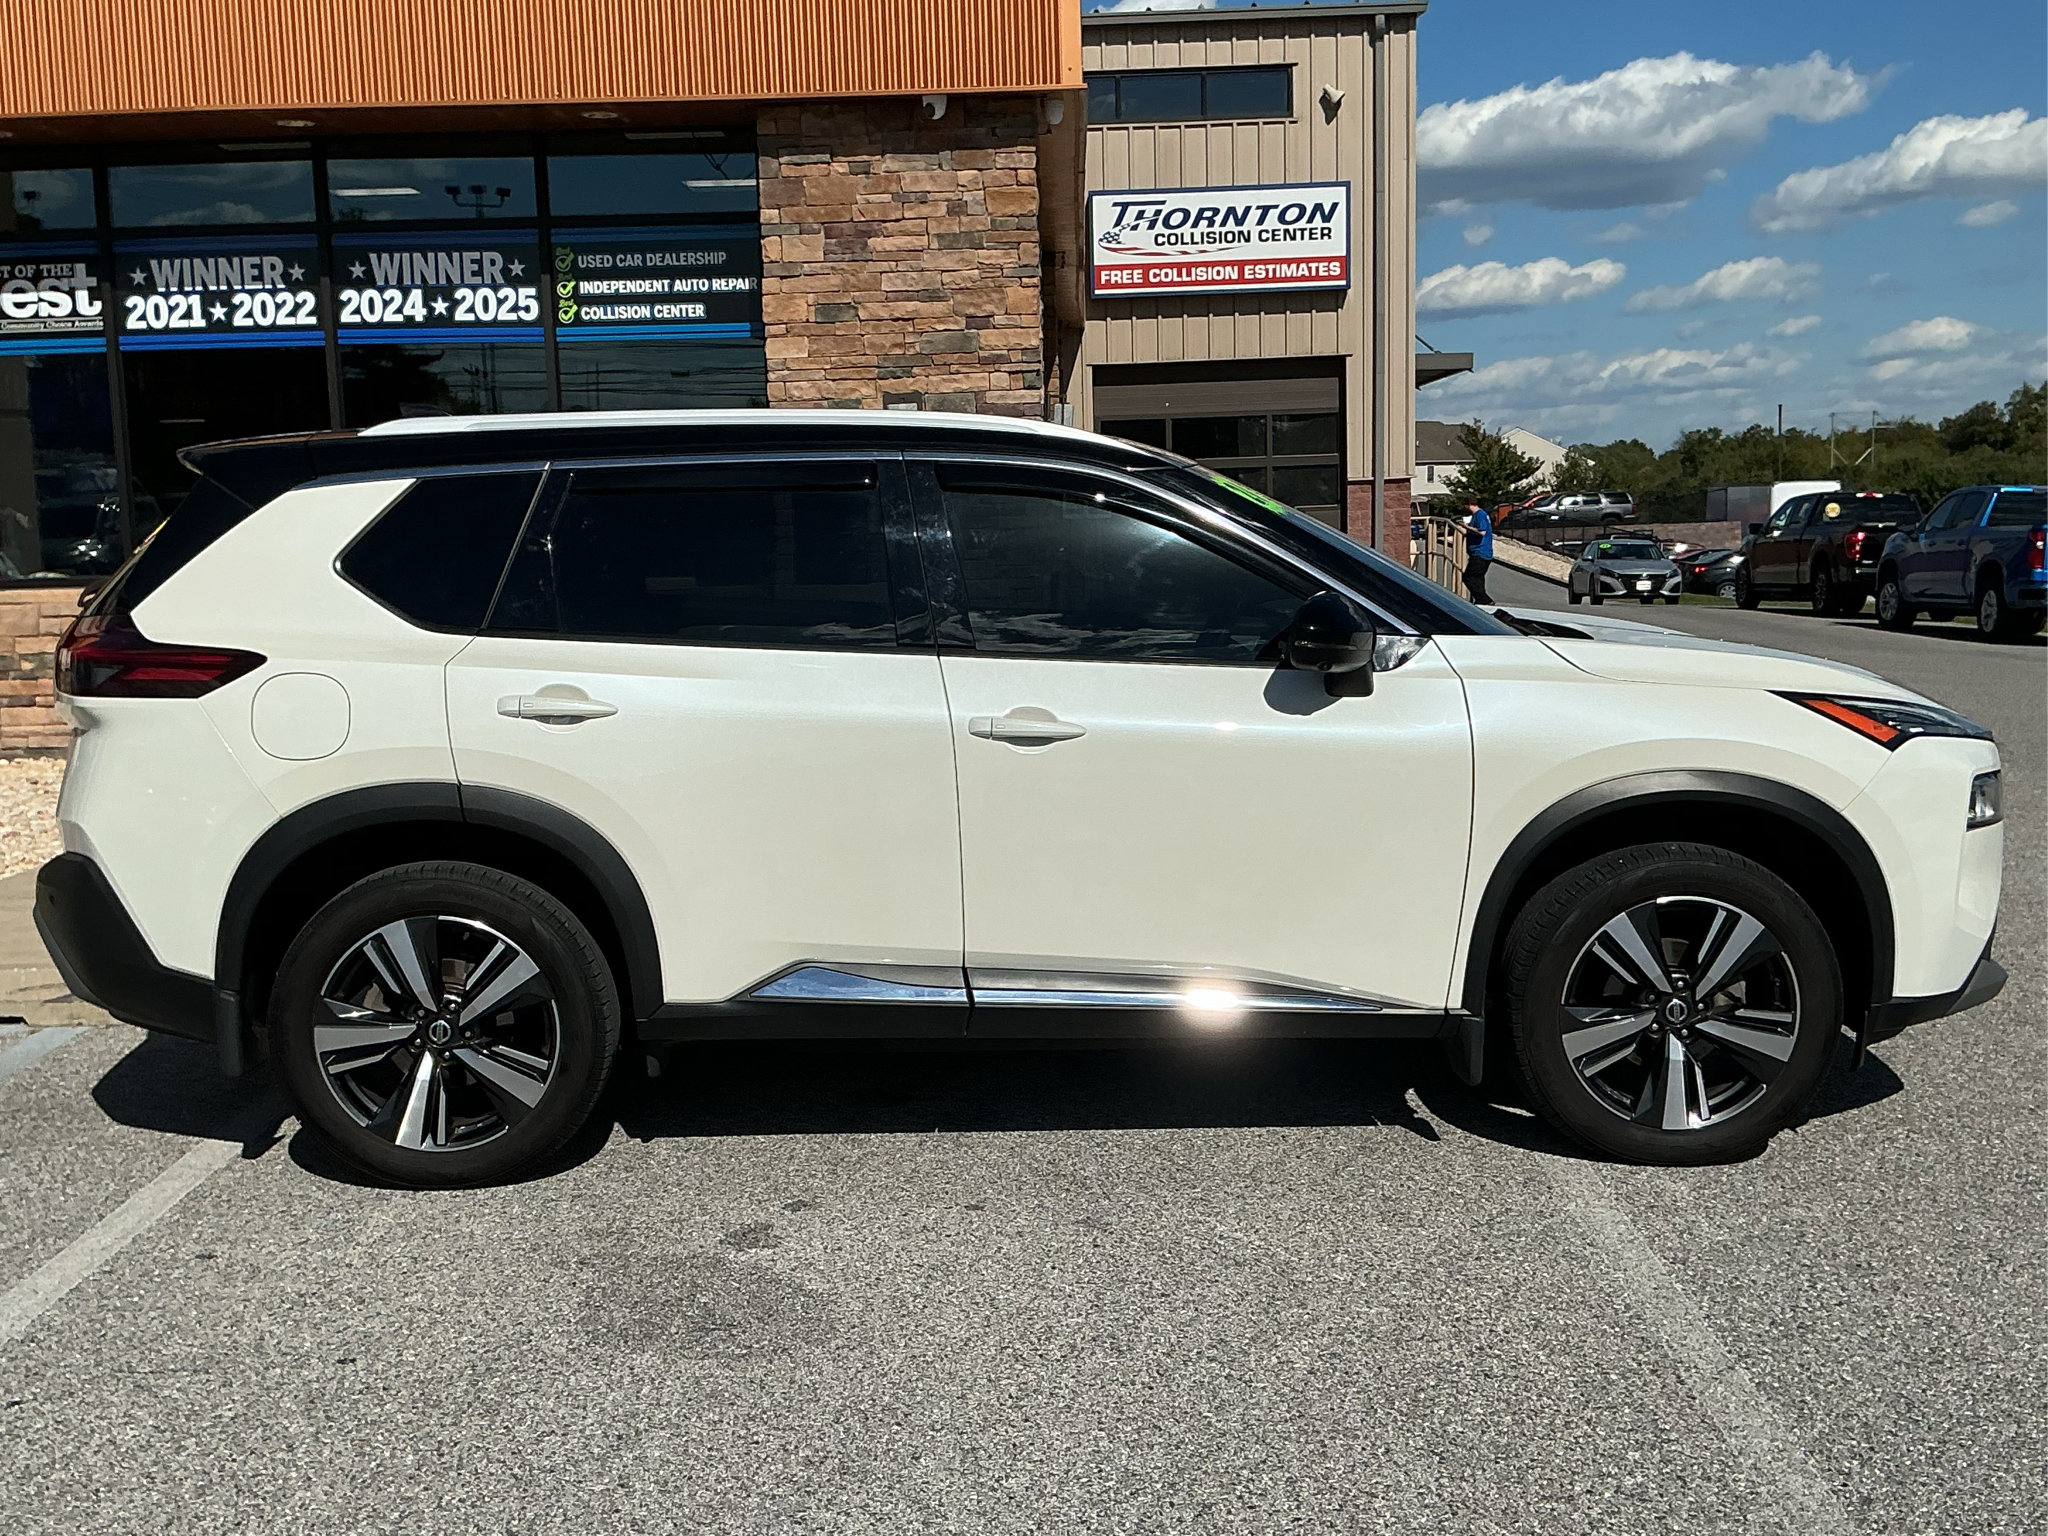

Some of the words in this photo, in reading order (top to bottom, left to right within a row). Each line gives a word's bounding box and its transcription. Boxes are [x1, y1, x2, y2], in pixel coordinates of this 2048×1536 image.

[1111, 199, 1340, 232] THORNTON
[1153, 229, 1252, 247] COLLISION
[1257, 226, 1333, 243] CENTER
[14, 264, 37, 278] OF
[39, 263, 73, 277] THE
[369, 251, 506, 287] WINNER
[577, 254, 614, 269] USED
[616, 253, 643, 268] CAR
[646, 251, 727, 267] DEALERSHIP
[150, 255, 287, 293] WINNER
[1100, 268, 1144, 285] FREE
[1149, 265, 1239, 283] COLLISION
[1243, 261, 1342, 280] ESTIMATES
[579, 279, 671, 295] INDEPENDENT
[673, 278, 709, 292] AUTO
[712, 276, 758, 291] REPAIR
[125, 294, 207, 330] 2021
[231, 291, 318, 327] 2022
[339, 287, 427, 323] 2024
[453, 287, 540, 322] 2025
[580, 305, 651, 320] COLLISION
[653, 303, 705, 319] CENTER
